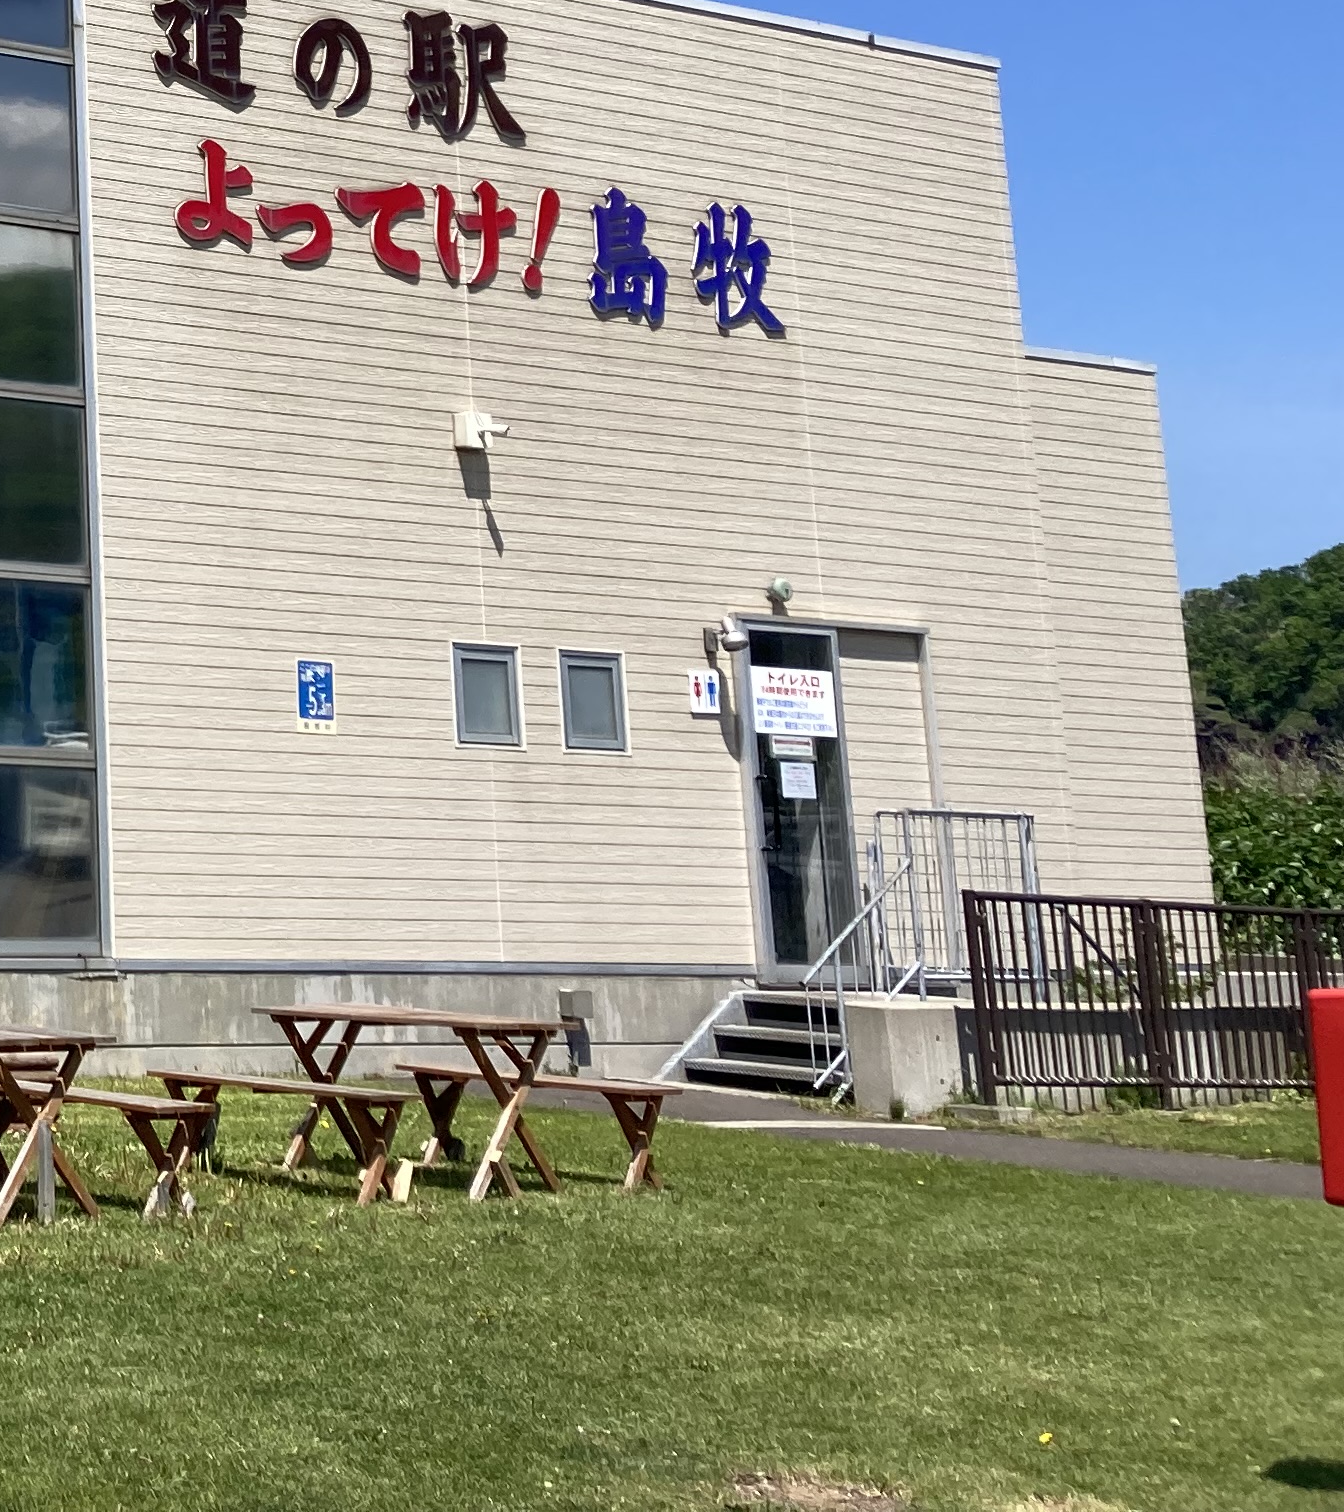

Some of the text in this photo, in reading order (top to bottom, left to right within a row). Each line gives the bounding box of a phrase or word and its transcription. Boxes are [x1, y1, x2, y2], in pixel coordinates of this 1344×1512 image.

[767, 671, 821, 688] トイレ入口
